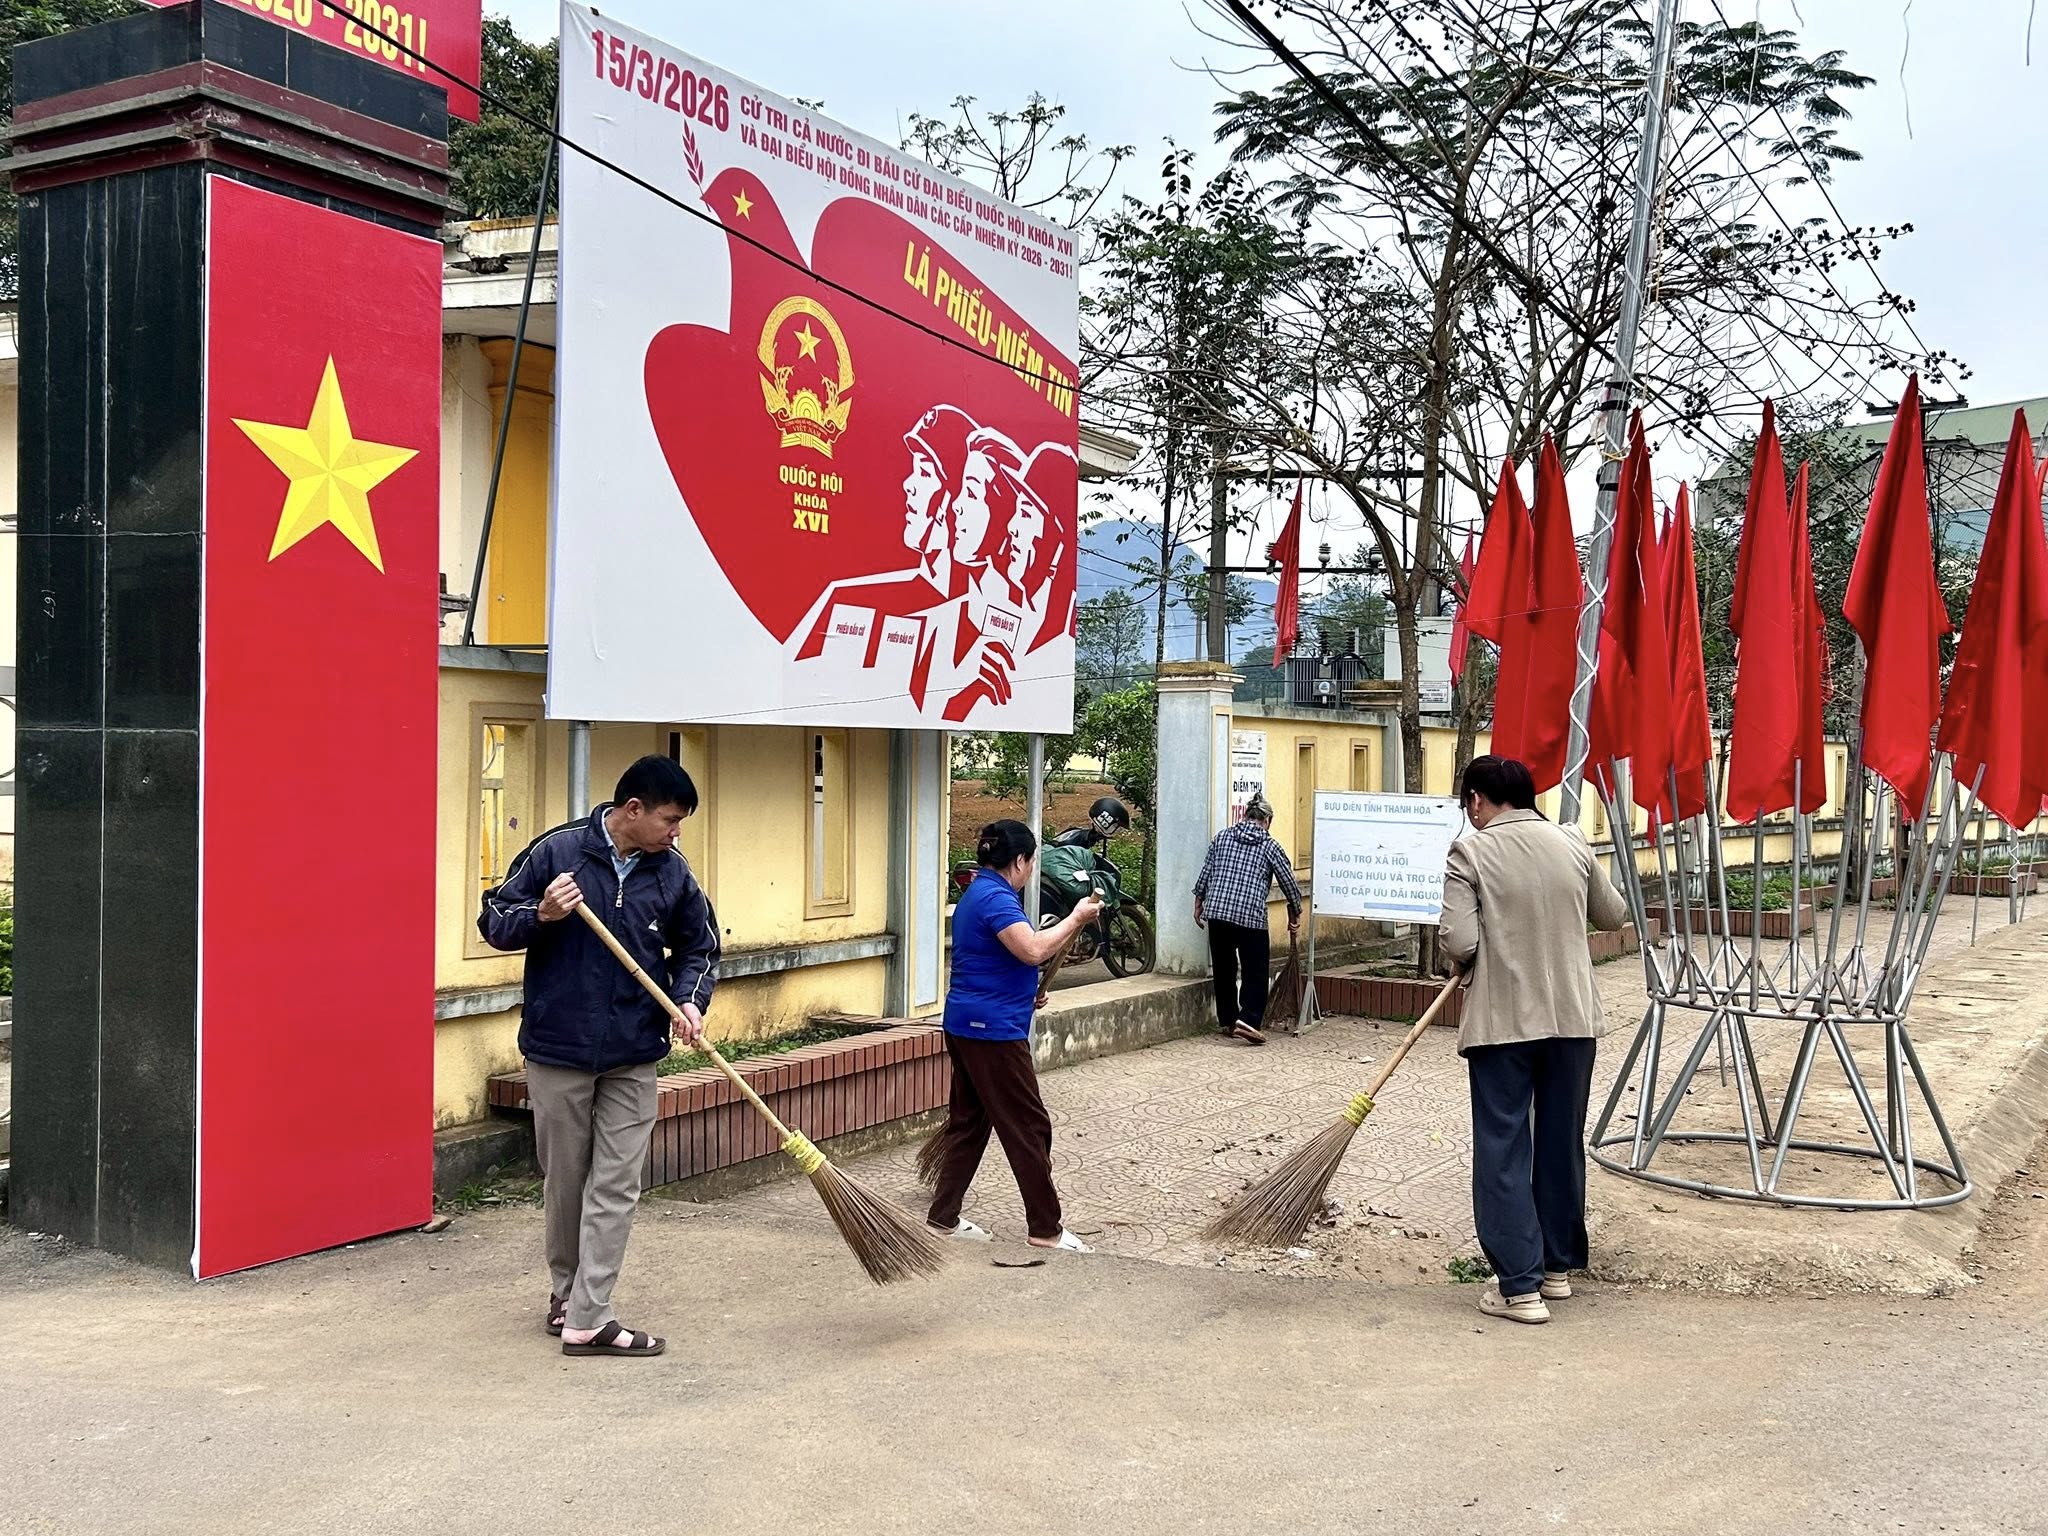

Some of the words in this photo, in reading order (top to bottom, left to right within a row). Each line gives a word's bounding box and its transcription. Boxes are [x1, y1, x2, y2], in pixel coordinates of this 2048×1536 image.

[344, 0, 427, 73] 2031!
[592, 29, 729, 132] 15/3/2026
[741, 95, 762, 120] CỬ
[765, 106, 788, 133] TRI
[793, 117, 811, 142] CẢ
[816, 128, 853, 160] NƯỚC
[857, 147, 870, 169] ĐI
[874, 154, 899, 181] BẦU
[903, 167, 921, 190] CỬ
[923, 177, 943, 202] ĐẠI
[946, 187, 972, 213] BIỂU
[975, 201, 1004, 227] QUỐC
[1008, 216, 1024, 238] HỘI
[1028, 224, 1054, 249] KHÓA
[1057, 237, 1072, 257] XVI
[741, 123, 757, 147] VÀ
[761, 132, 781, 159] ĐẠI
[786, 142, 812, 170] BIỂU
[817, 156, 836, 182] HỘI
[840, 165, 870, 195] ĐỒNG
[873, 181, 903, 209] NHÂN
[907, 195, 928, 219] DÂN
[931, 205, 950, 229] CÁC
[954, 214, 972, 237] CẤP
[975, 225, 1005, 252] NHIỆM
[1008, 238, 1019, 257] KỲ
[1021, 245, 1042, 267] 2026
[1050, 257, 1072, 279] 2031!
[904, 240, 931, 298] LÁ
[1046, 362, 1074, 418] TIN
[779, 464, 816, 488] QUỐC
[821, 472, 843, 496] HỘI
[794, 492, 828, 510] KHÓA
[793, 509, 829, 534] XVI
[1384, 804, 1411, 814] THANH
[1428, 871, 1442, 884] CẤ
